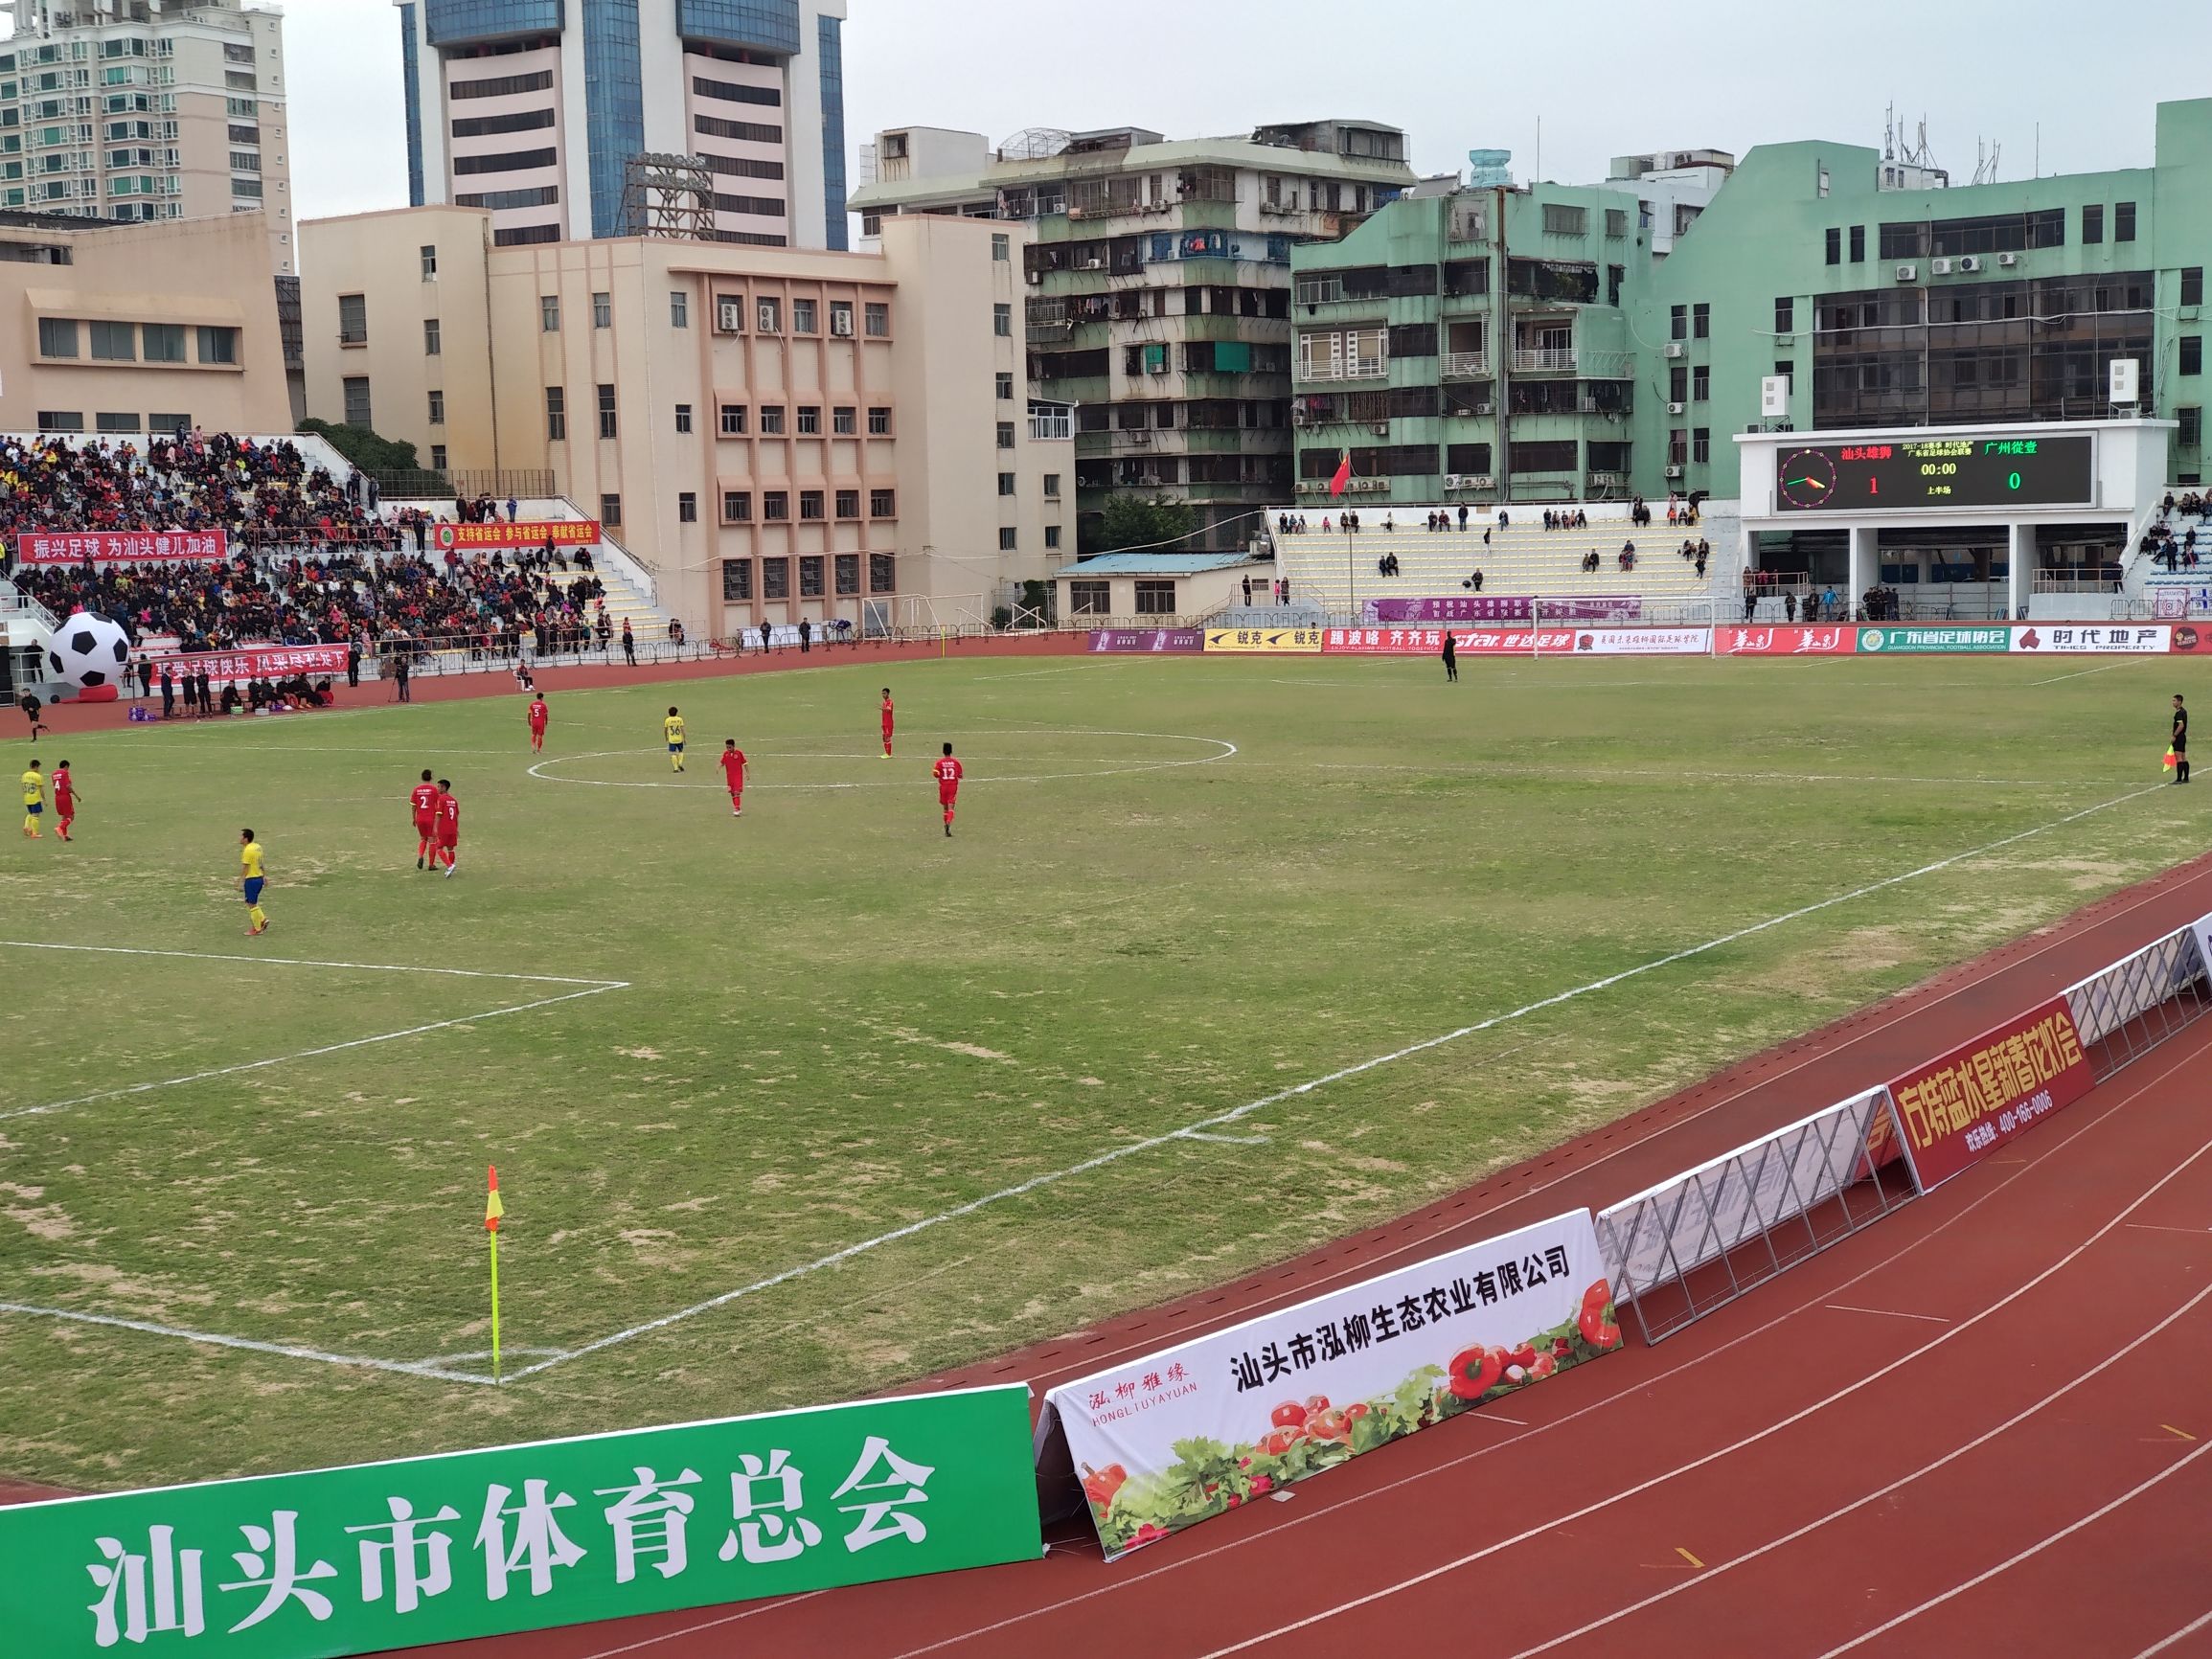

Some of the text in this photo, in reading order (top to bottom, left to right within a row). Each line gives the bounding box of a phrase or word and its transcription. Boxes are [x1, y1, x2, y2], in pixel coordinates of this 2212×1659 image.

[1921, 463, 1956, 475] 00:00
[1870, 477, 1878, 493] 1
[2009, 472, 2020, 489] 0
[1927, 486, 1951, 494] 上半场
[458, 523, 592, 542] 支持省运会 参与省运会 奉献省运会
[34, 535, 217, 559] 振兴足球 为汕头健儿加油
[1237, 631, 1263, 645] 锐克
[1293, 631, 1320, 645] 锐克
[1390, 630, 1440, 645] 齐齐玩
[1502, 633, 1571, 648] 世达足球
[1890, 630, 2005, 645] 广东省足球协会
[2053, 629, 2157, 644] 时代地产
[942, 767, 955, 780] 12
[420, 796, 429, 808] 2
[448, 807, 455, 821] 9
[1898, 1011, 2083, 1149] 方特蓝水星新春花灯会
[1998, 1089, 2053, 1134] 400-166-0006
[1230, 1244, 1570, 1393] 汕头市泓柳生态农业有限公司
[1088, 1362, 1190, 1410] 泓柳雅缘
[1092, 1382, 1197, 1427] HONGLIUYAYUAN
[85, 1436, 937, 1648] 汕头市体育总会
